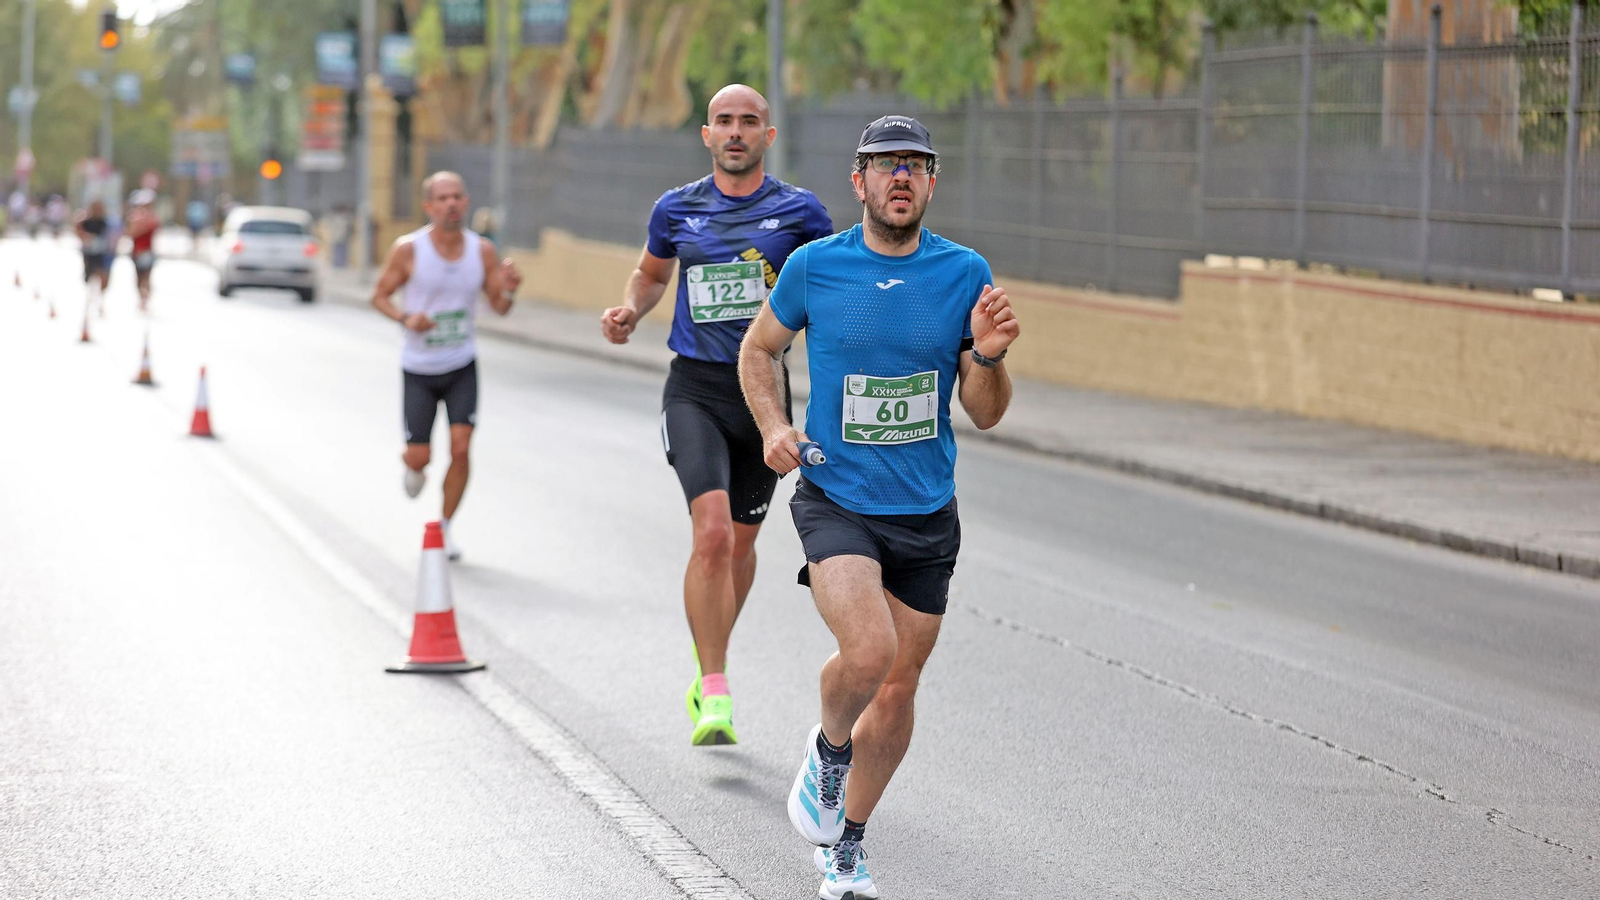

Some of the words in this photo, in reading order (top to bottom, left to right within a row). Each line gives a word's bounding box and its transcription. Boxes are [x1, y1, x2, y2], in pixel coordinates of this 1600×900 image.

[884, 121, 911, 129] KIPRUN
[708, 282, 746, 302] 122
[872, 388, 897, 396] XXIX
[876, 401, 908, 422] 60
